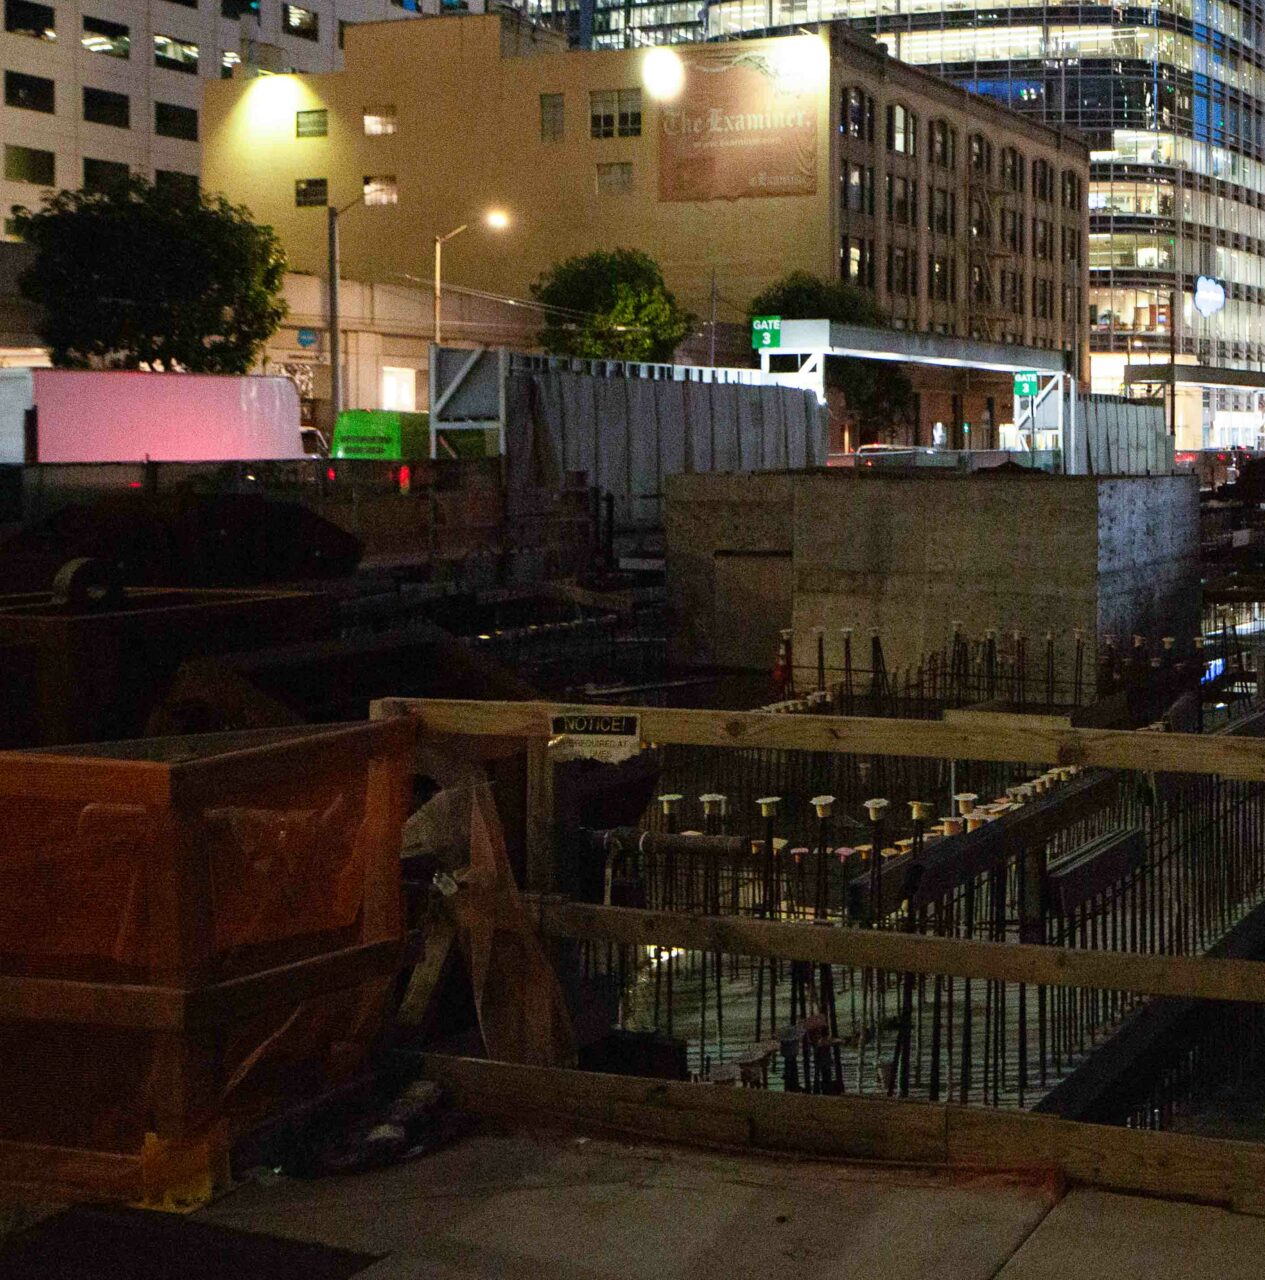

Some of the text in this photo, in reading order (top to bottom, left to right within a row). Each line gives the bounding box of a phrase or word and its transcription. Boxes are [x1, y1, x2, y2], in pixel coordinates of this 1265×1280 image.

[664, 109, 703, 136] The
[753, 320, 780, 330] GATE
[762, 332, 771, 345] 3
[1014, 373, 1038, 382] GATE
[564, 716, 626, 732] NOTICE!
